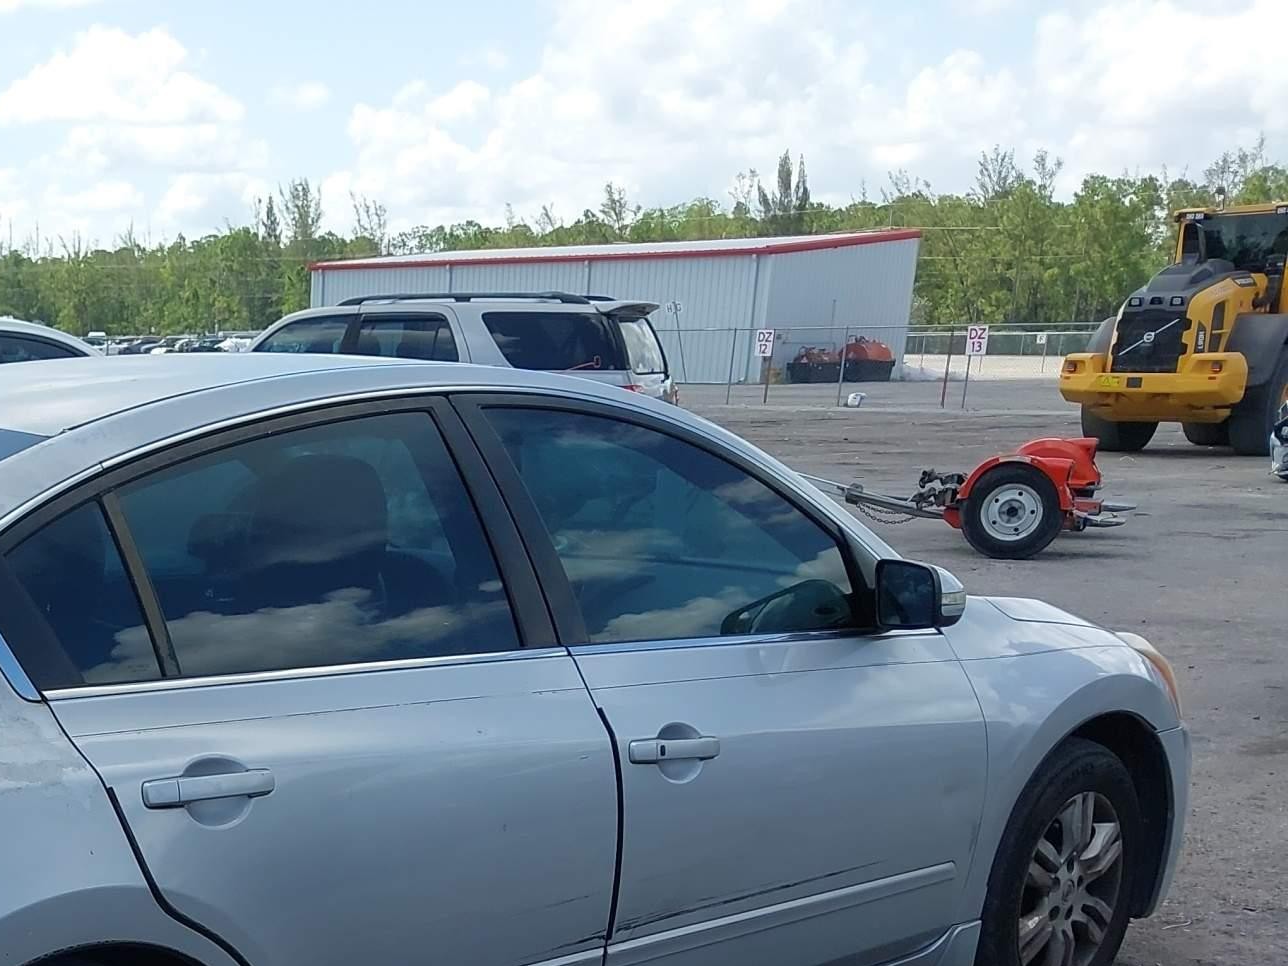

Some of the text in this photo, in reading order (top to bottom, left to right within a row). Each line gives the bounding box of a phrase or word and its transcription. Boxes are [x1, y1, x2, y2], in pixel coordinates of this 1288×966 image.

[757, 331, 773, 343] DZ
[969, 327, 987, 340] DZ
[759, 343, 768, 354] 12
[971, 341, 982, 353] 13
